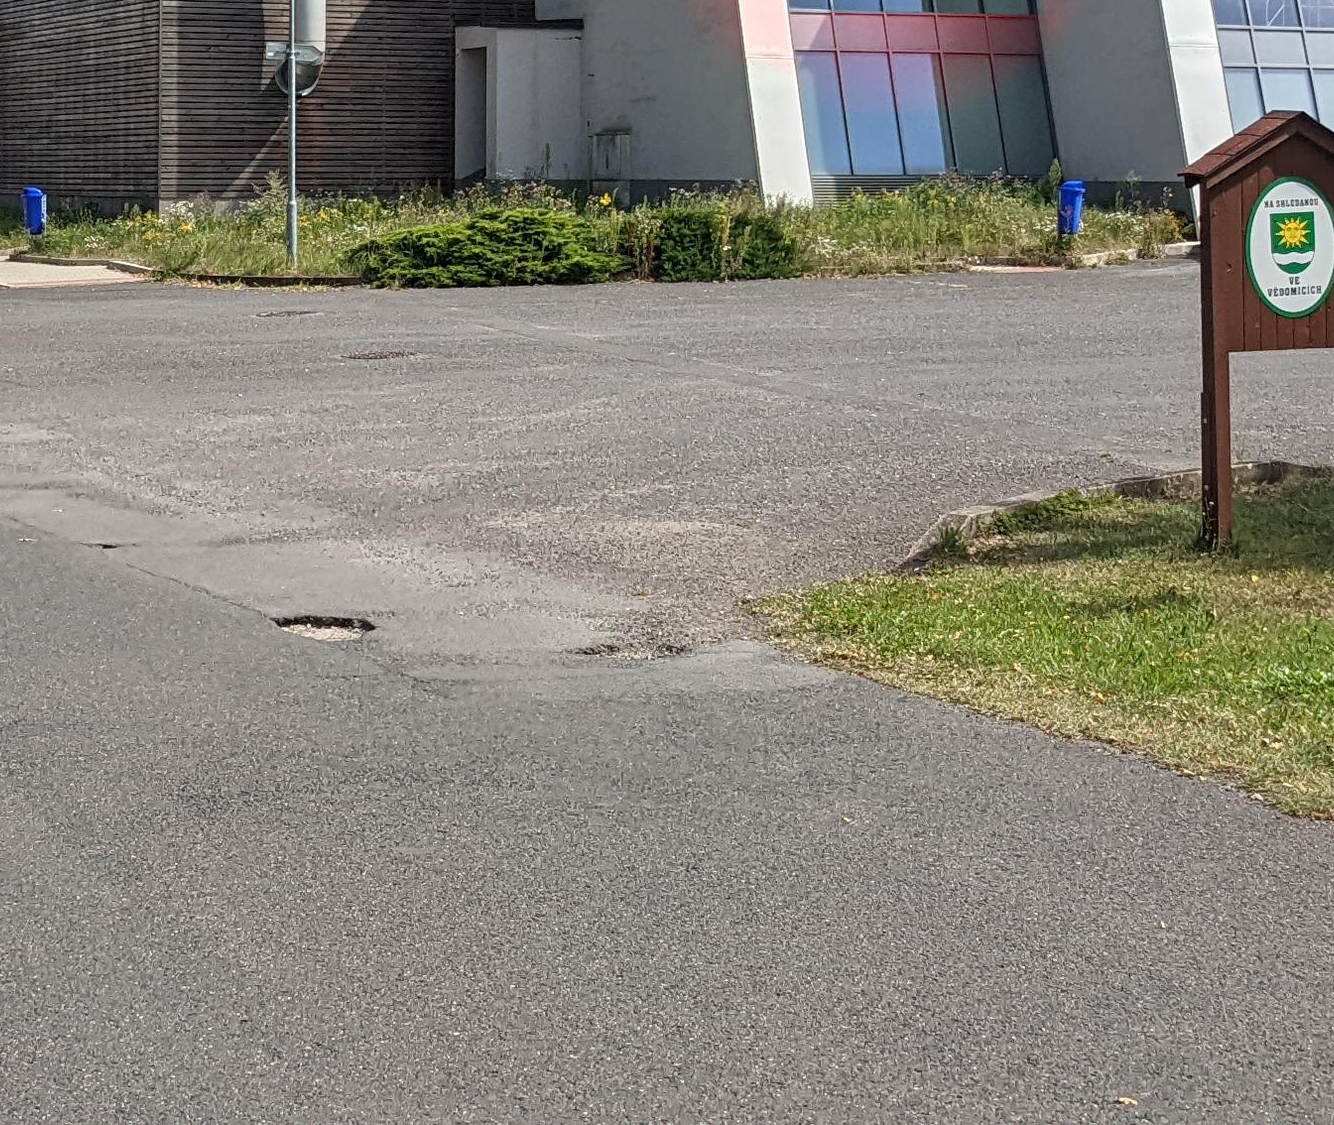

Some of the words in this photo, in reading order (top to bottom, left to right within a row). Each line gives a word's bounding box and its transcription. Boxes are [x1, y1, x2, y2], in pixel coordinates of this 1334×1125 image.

[1264, 200, 1274, 208] NA
[1276, 198, 1319, 208] SHLEDANOU
[1289, 276, 1300, 285] VE
[1267, 284, 1322, 297] VĚDOMICÍCH
